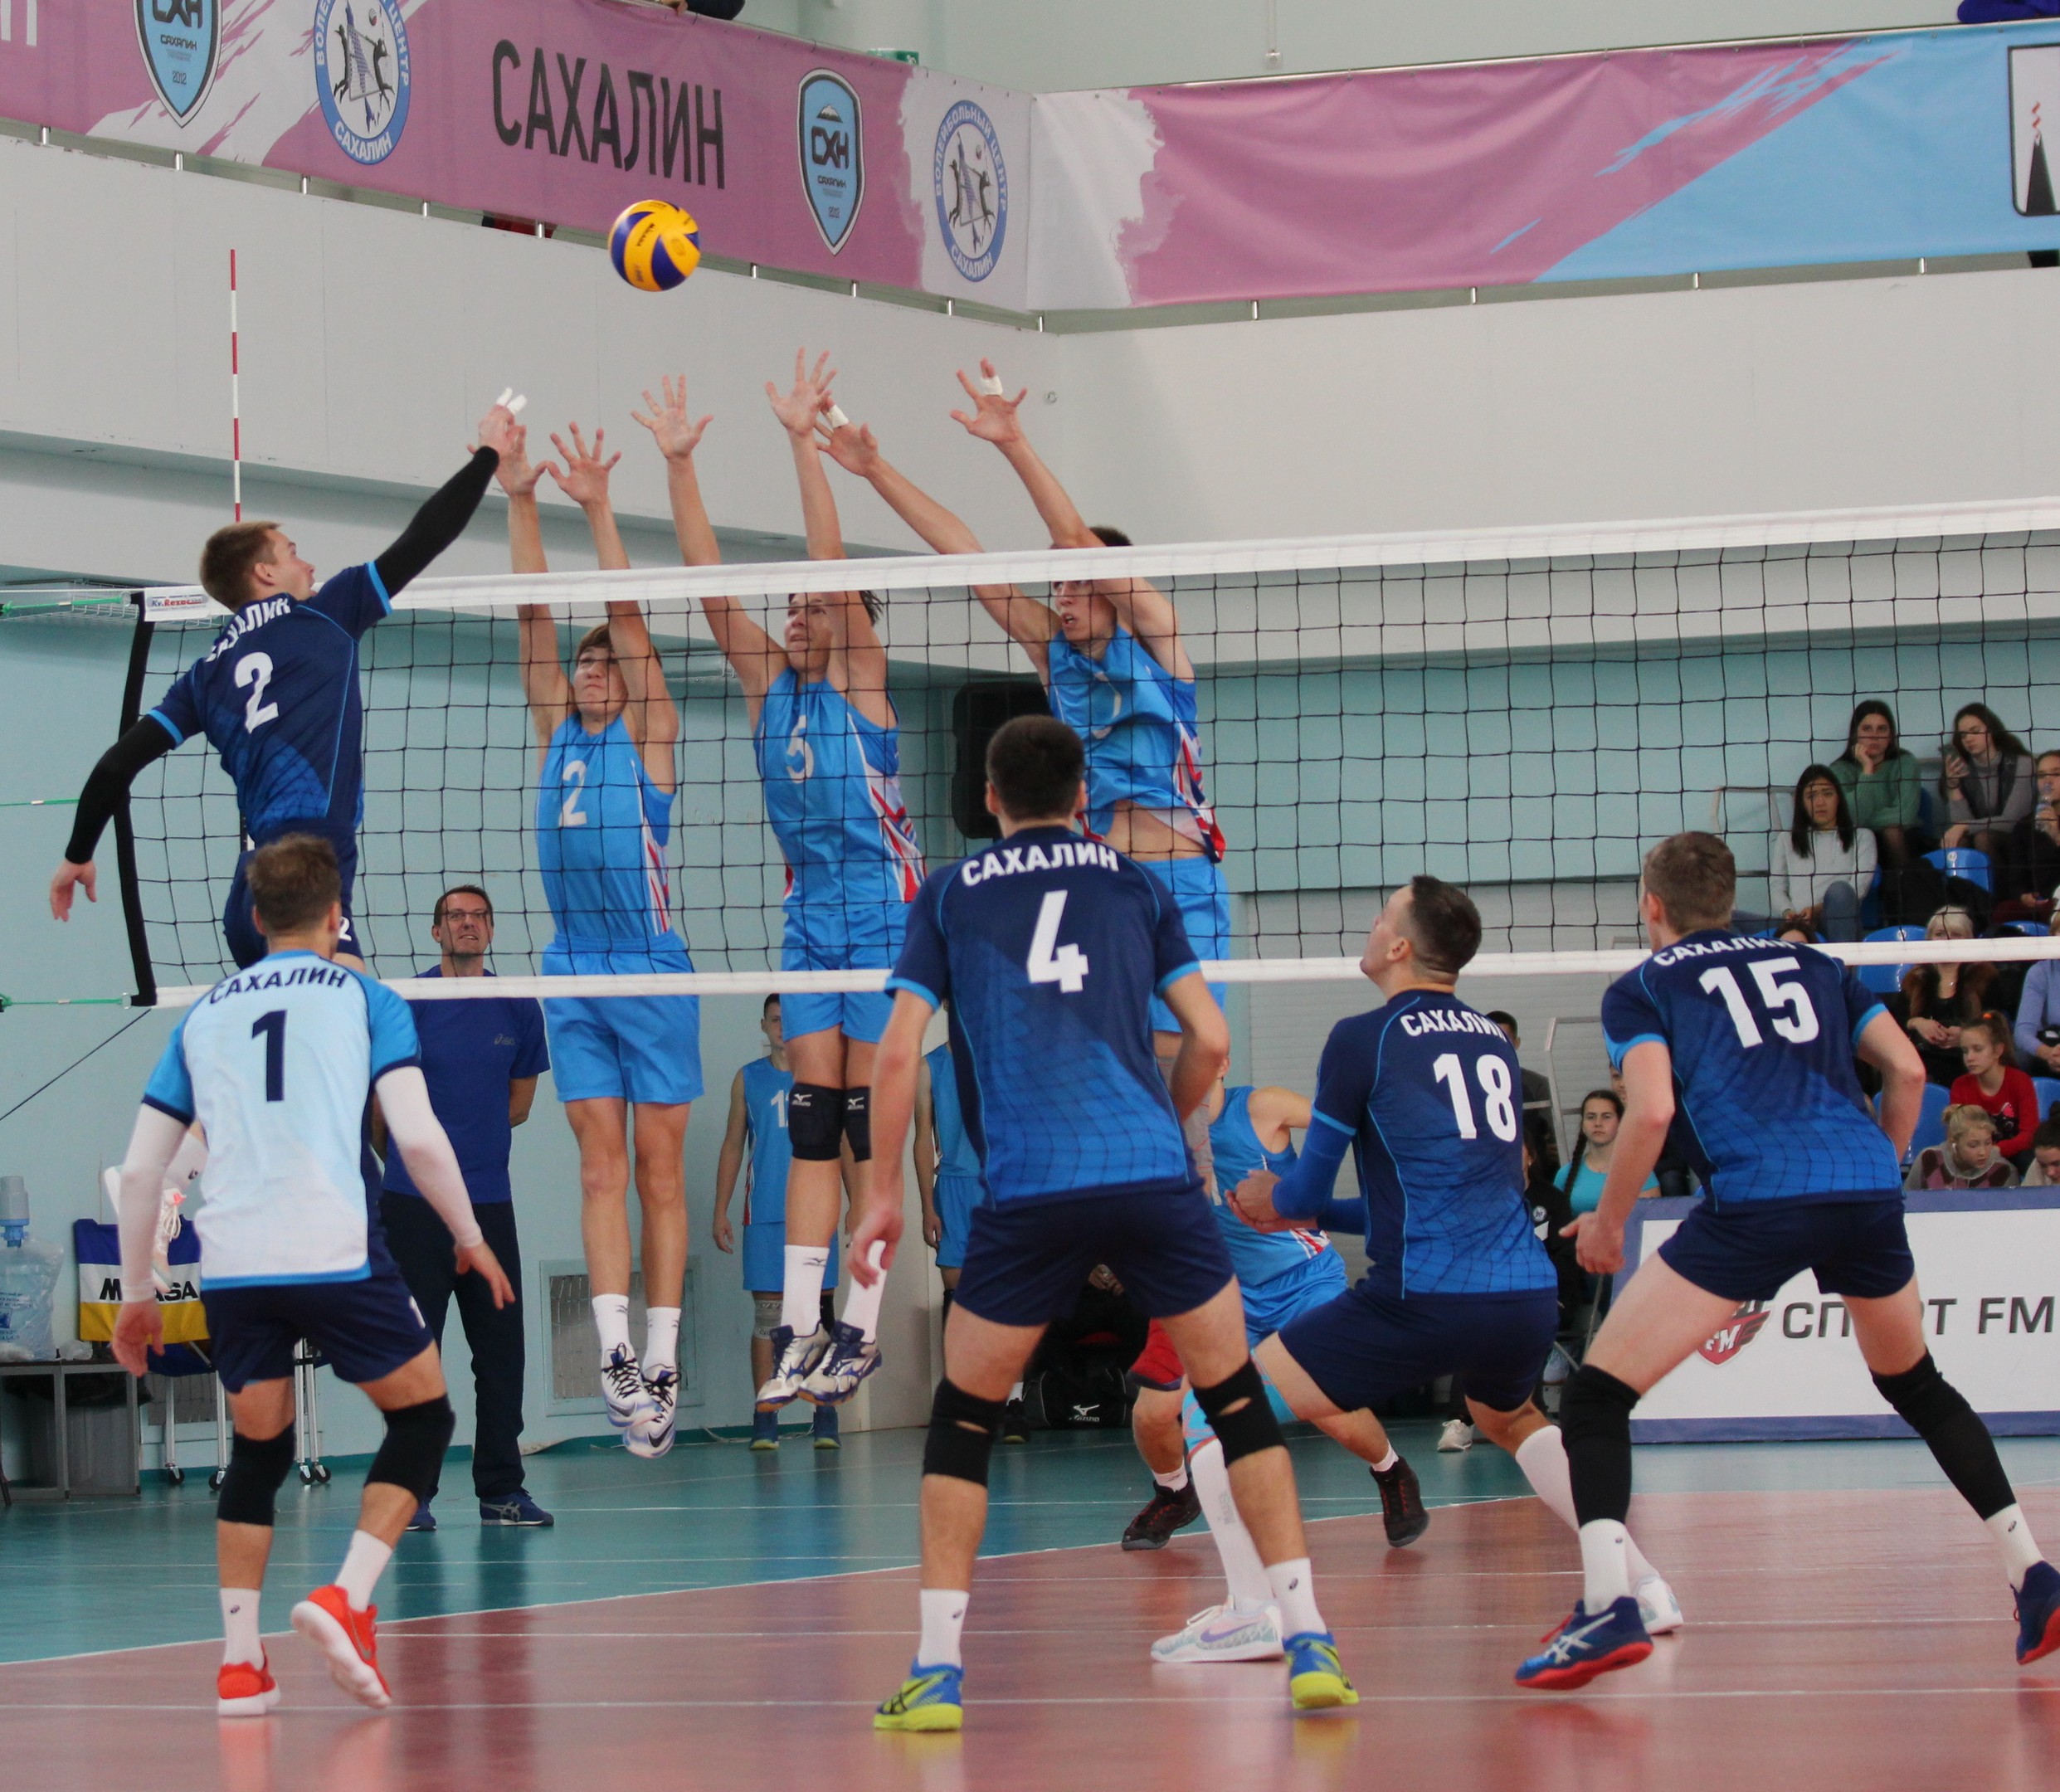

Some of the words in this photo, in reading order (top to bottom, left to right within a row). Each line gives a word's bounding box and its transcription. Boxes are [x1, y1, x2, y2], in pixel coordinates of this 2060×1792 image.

[388, 2, 410, 87] ЦЕНТР
[173, 70, 187, 85] 2012
[335, 120, 393, 161] САХАЛИН
[493, 38, 726, 190] САХАЛИН
[951, 244, 994, 279] САХАЛИН
[235, 651, 279, 734] 2
[558, 759, 588, 827] 2
[962, 841, 1119, 887] САХАЛИН
[1027, 889, 1089, 993] 4
[210, 967, 349, 1005] САХАЛИН
[1698, 957, 1819, 1049] 15
[251, 1009, 287, 1103] 1
[771, 1089, 789, 1128] 1
[1433, 1053, 1517, 1143] 18
[100, 1278, 198, 1302] MSA
[1783, 1298, 1957, 1339] СПТ
[1978, 1296, 2055, 1335] FM
